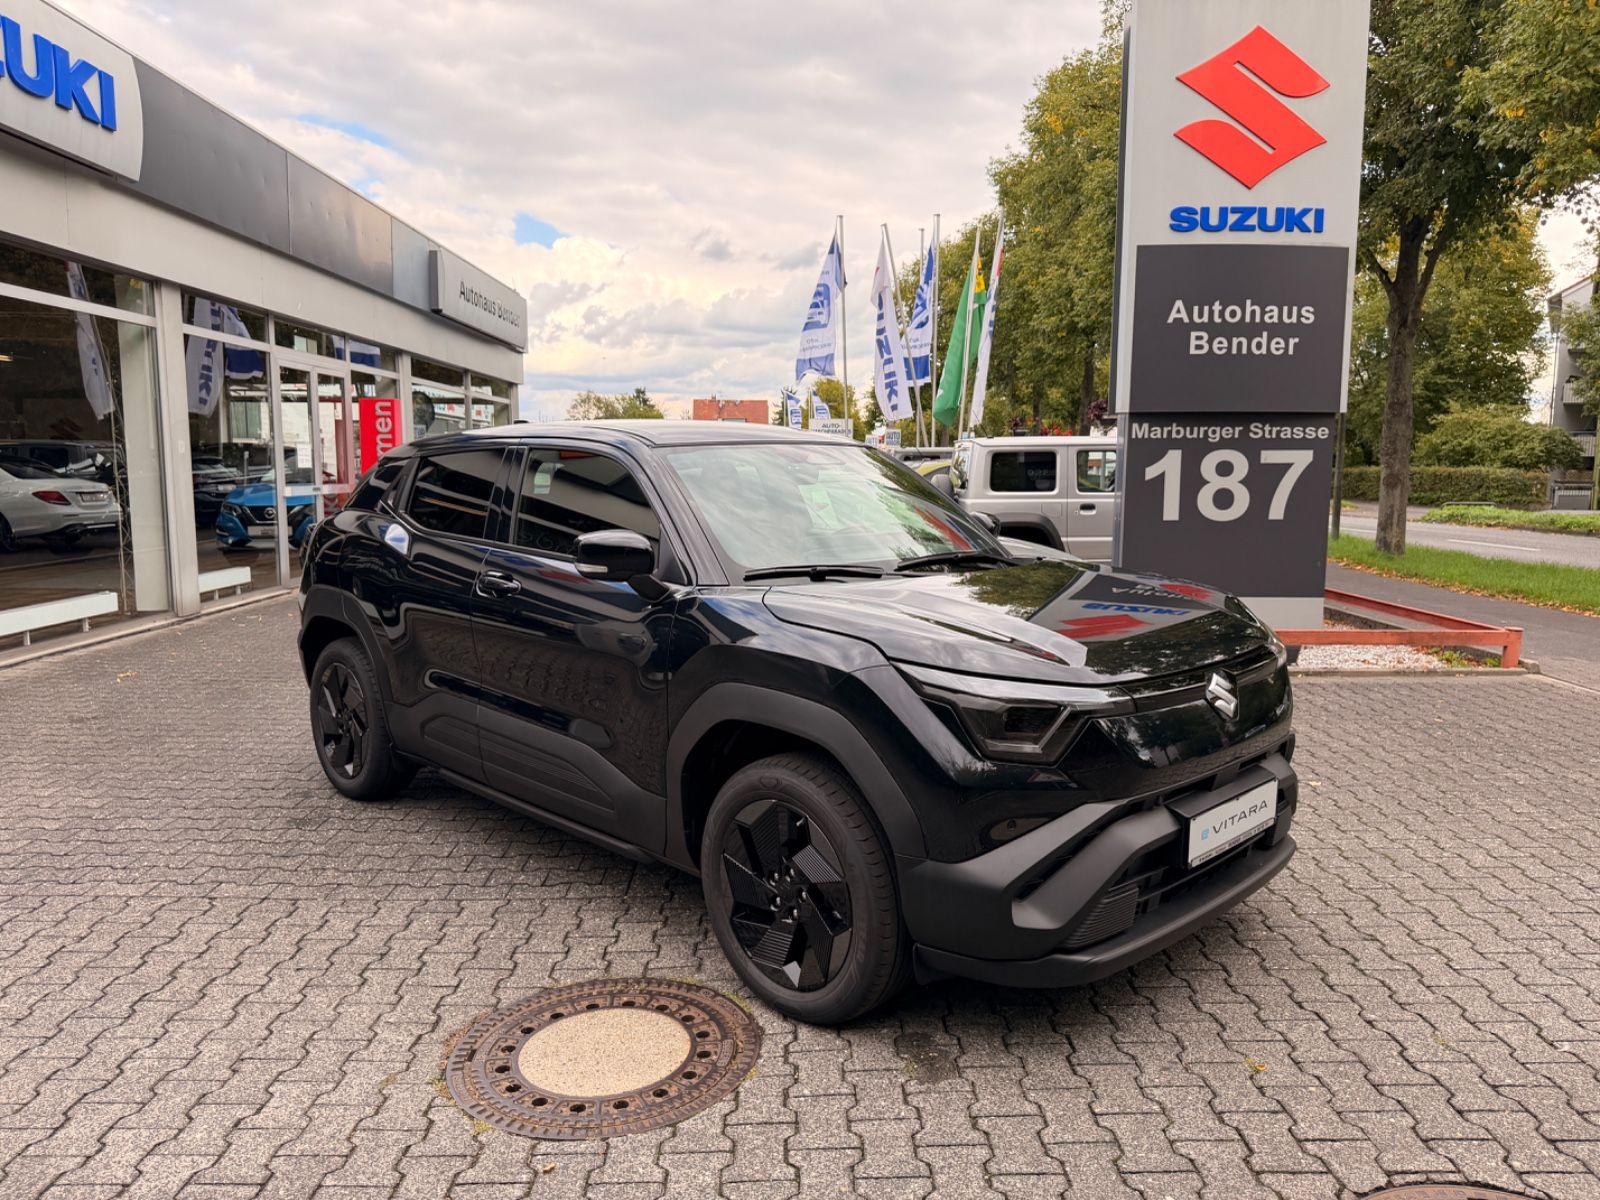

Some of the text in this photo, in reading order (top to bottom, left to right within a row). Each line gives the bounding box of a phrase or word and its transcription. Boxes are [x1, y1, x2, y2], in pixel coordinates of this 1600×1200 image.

[0, 14, 117, 132] UKI
[1169, 206, 1324, 233] SUZUKI
[459, 281, 496, 317] Autohaus
[1167, 300, 1315, 324] Autohaus
[1189, 331, 1299, 355] Bender
[1131, 422, 1329, 442] Marburger Strasse
[1145, 449, 1314, 521] 187
